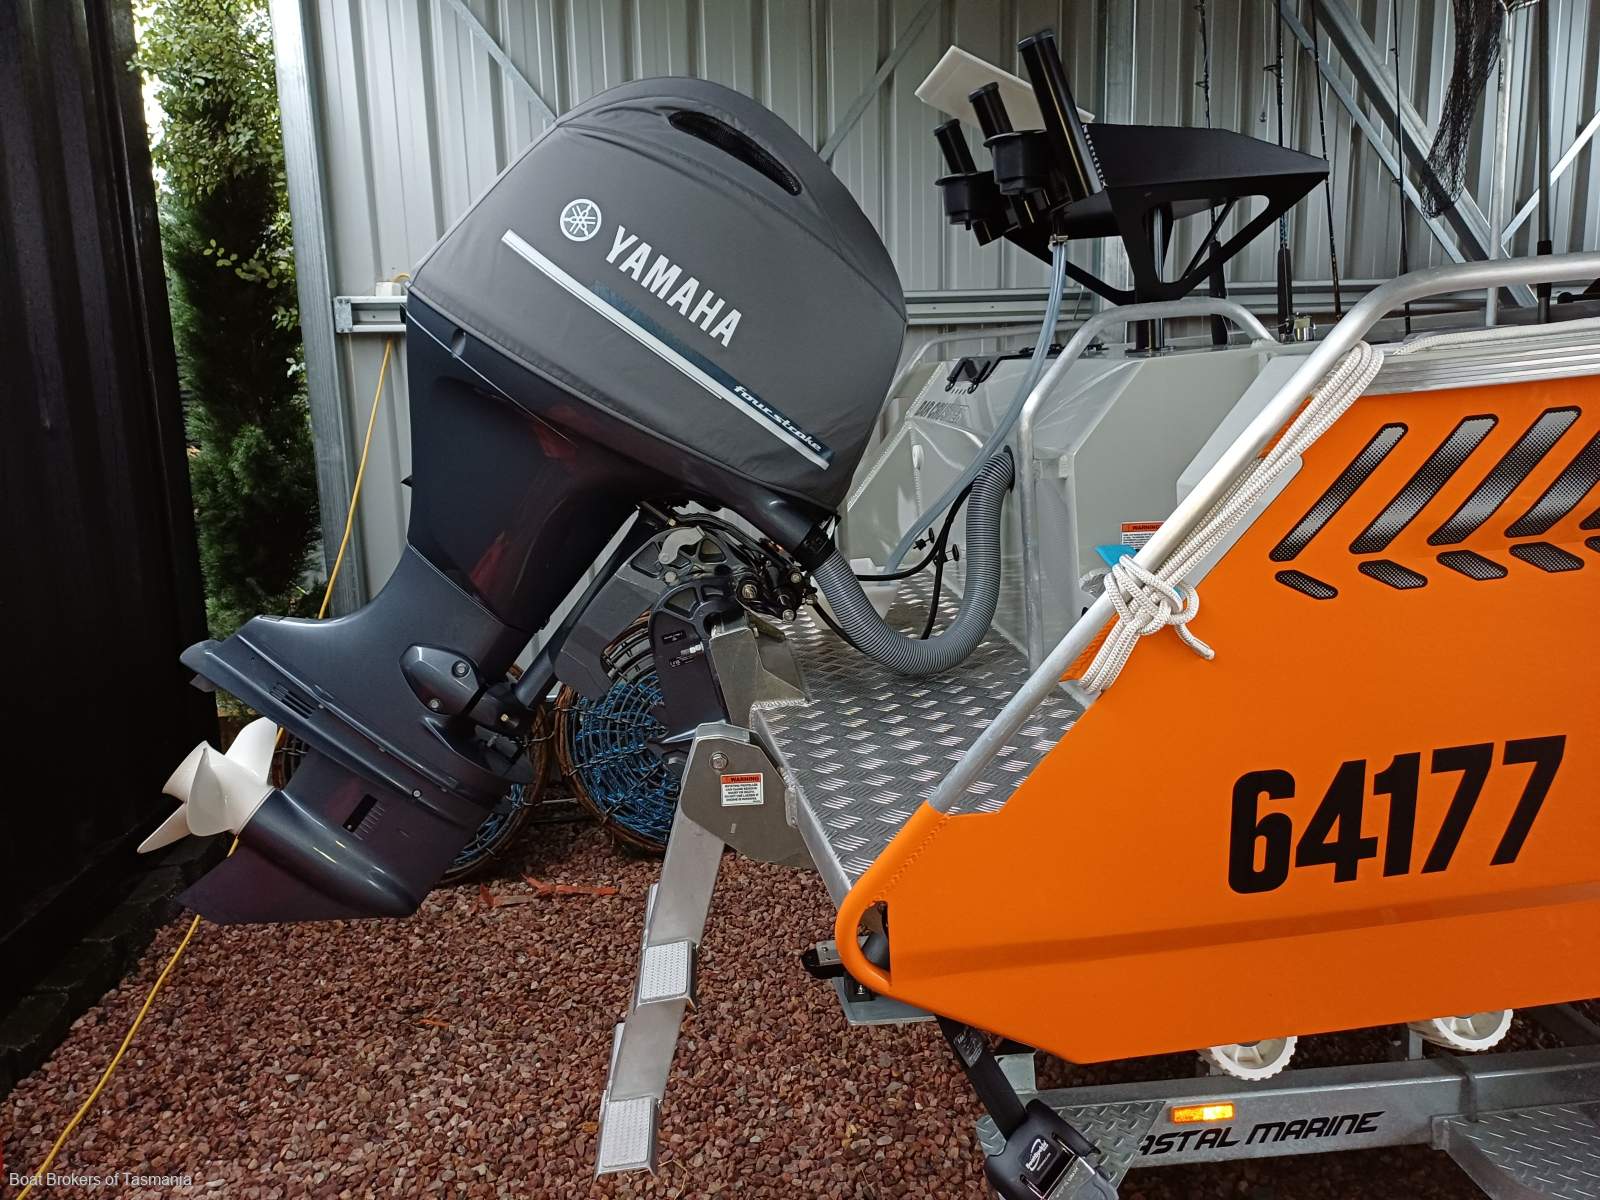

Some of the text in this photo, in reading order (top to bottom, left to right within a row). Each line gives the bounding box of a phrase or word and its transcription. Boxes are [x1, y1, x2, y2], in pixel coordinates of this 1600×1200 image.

[606, 225, 742, 347] YAMAHA
[1228, 734, 1567, 894] 64177
[1245, 1111, 1386, 1145] MARINE
